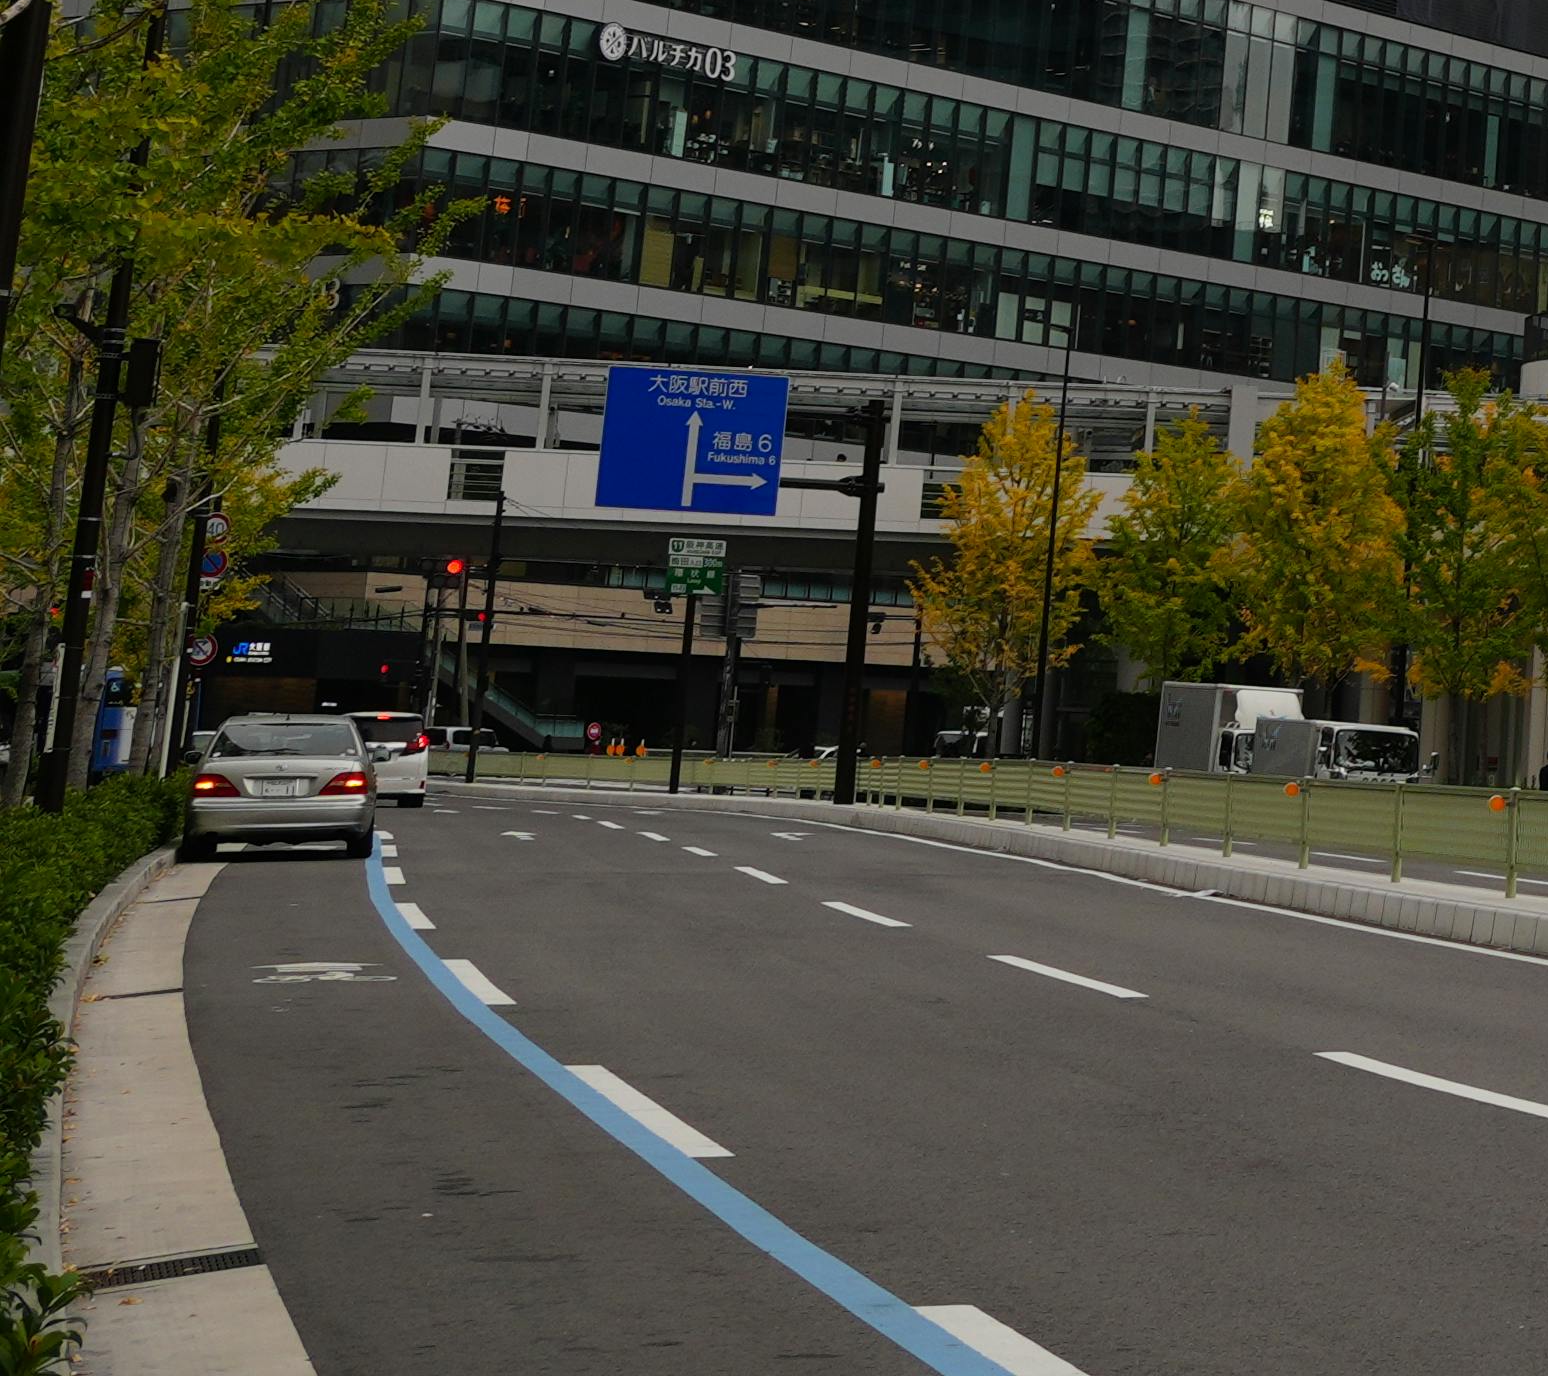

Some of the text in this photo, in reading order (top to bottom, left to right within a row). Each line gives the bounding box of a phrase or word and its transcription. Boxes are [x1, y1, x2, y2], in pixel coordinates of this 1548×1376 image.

[627, 36, 737, 82] バルチカ03
[648, 374, 749, 398] 大阪駅前西
[657, 395, 691, 408] Osaka
[712, 431, 773, 453] 福島 6
[707, 451, 776, 466] Fukushima 6
[207, 522, 225, 535] 40
